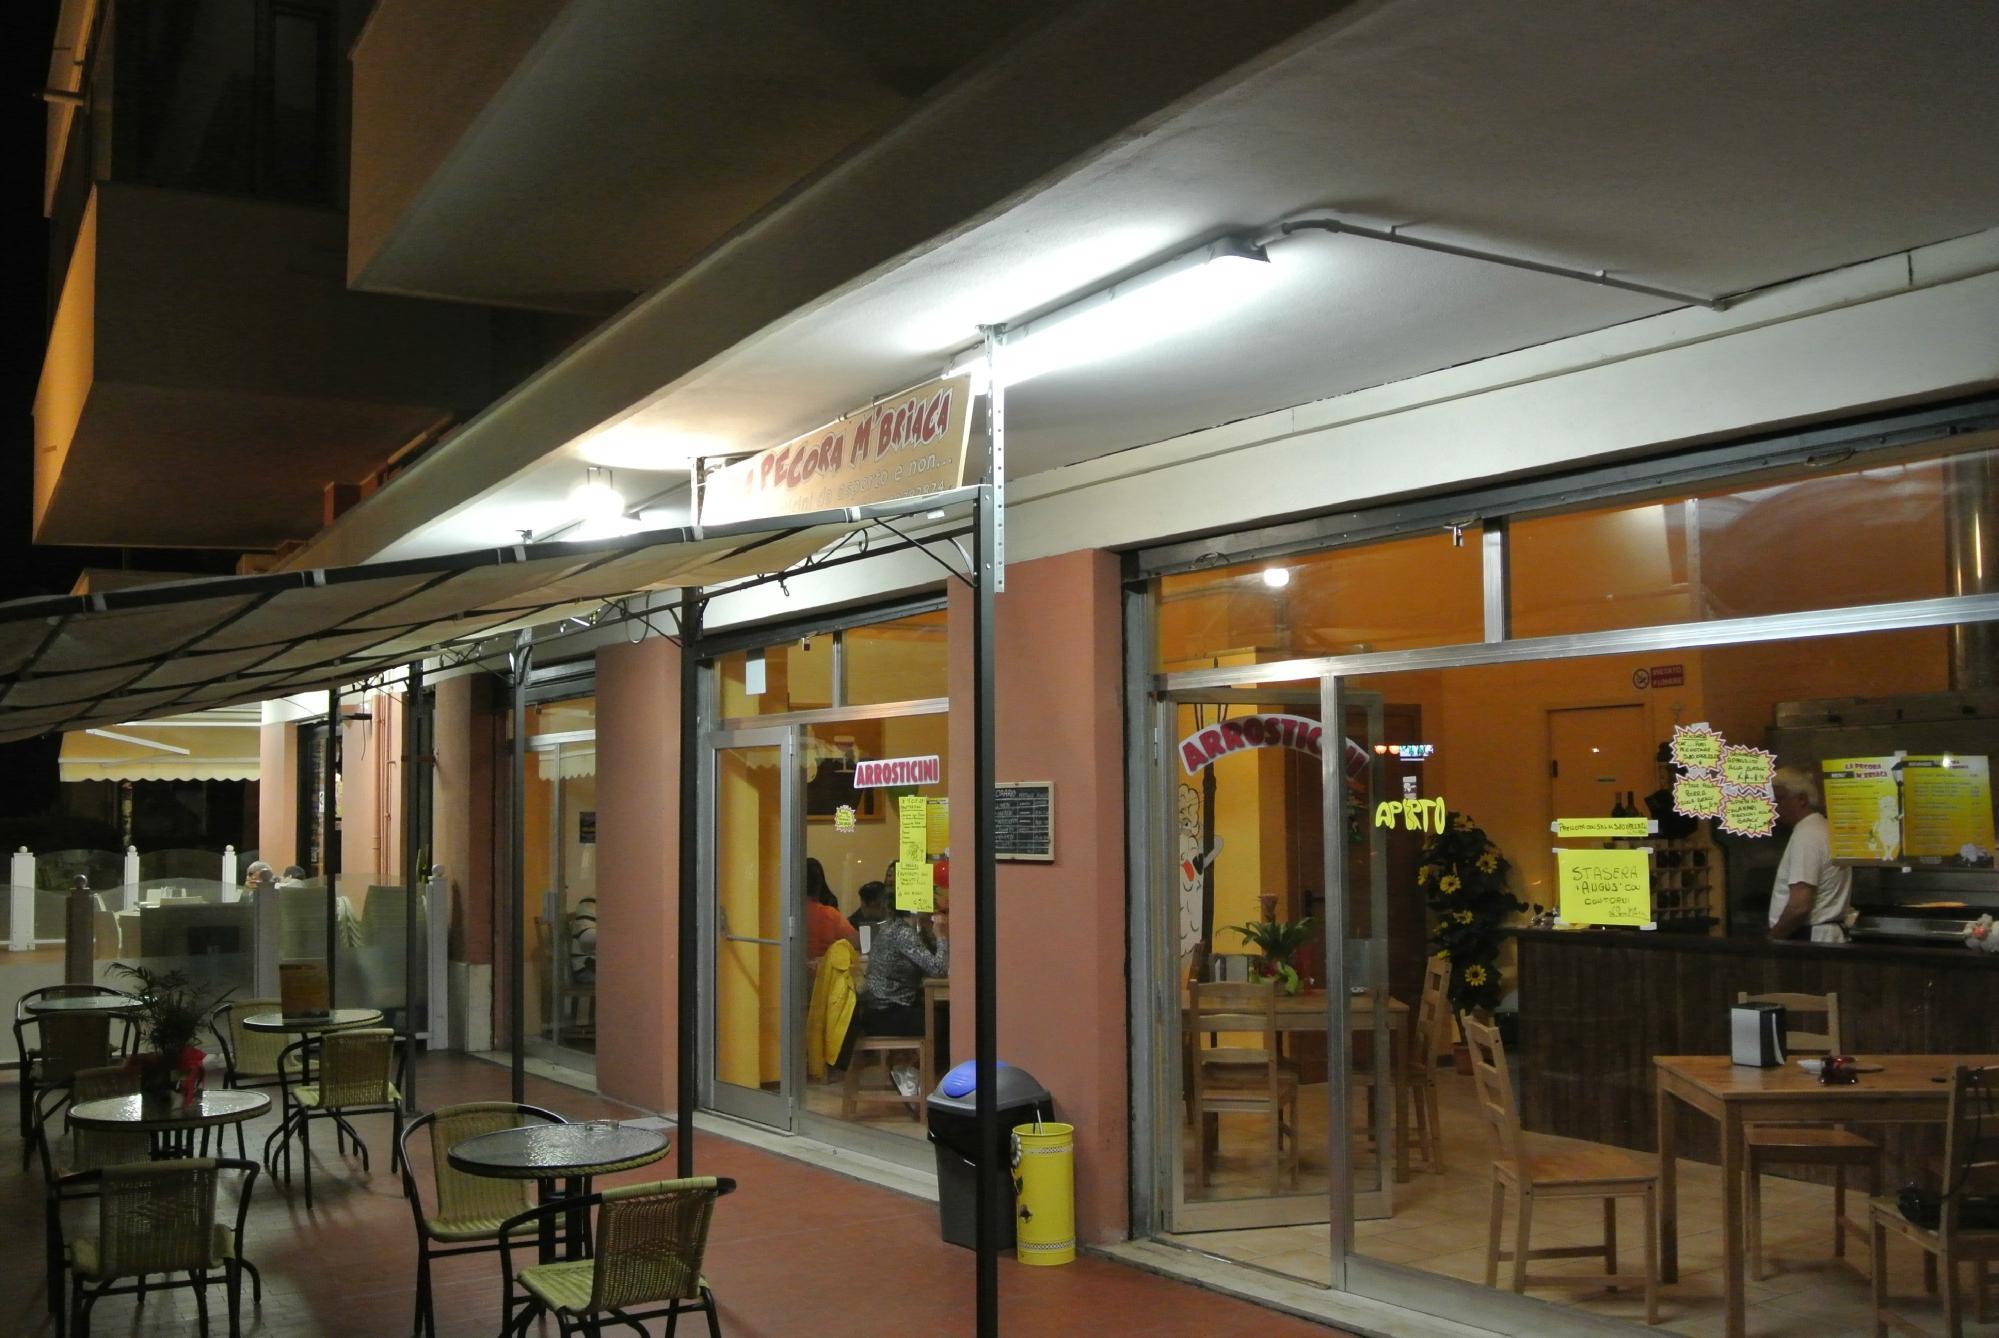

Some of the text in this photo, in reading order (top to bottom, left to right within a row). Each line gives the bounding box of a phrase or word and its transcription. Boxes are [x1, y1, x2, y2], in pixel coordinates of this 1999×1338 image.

[760, 432, 844, 491] PECORA
[856, 758, 939, 786] ARROSTICINI
[1572, 866, 1638, 881] STASERA
